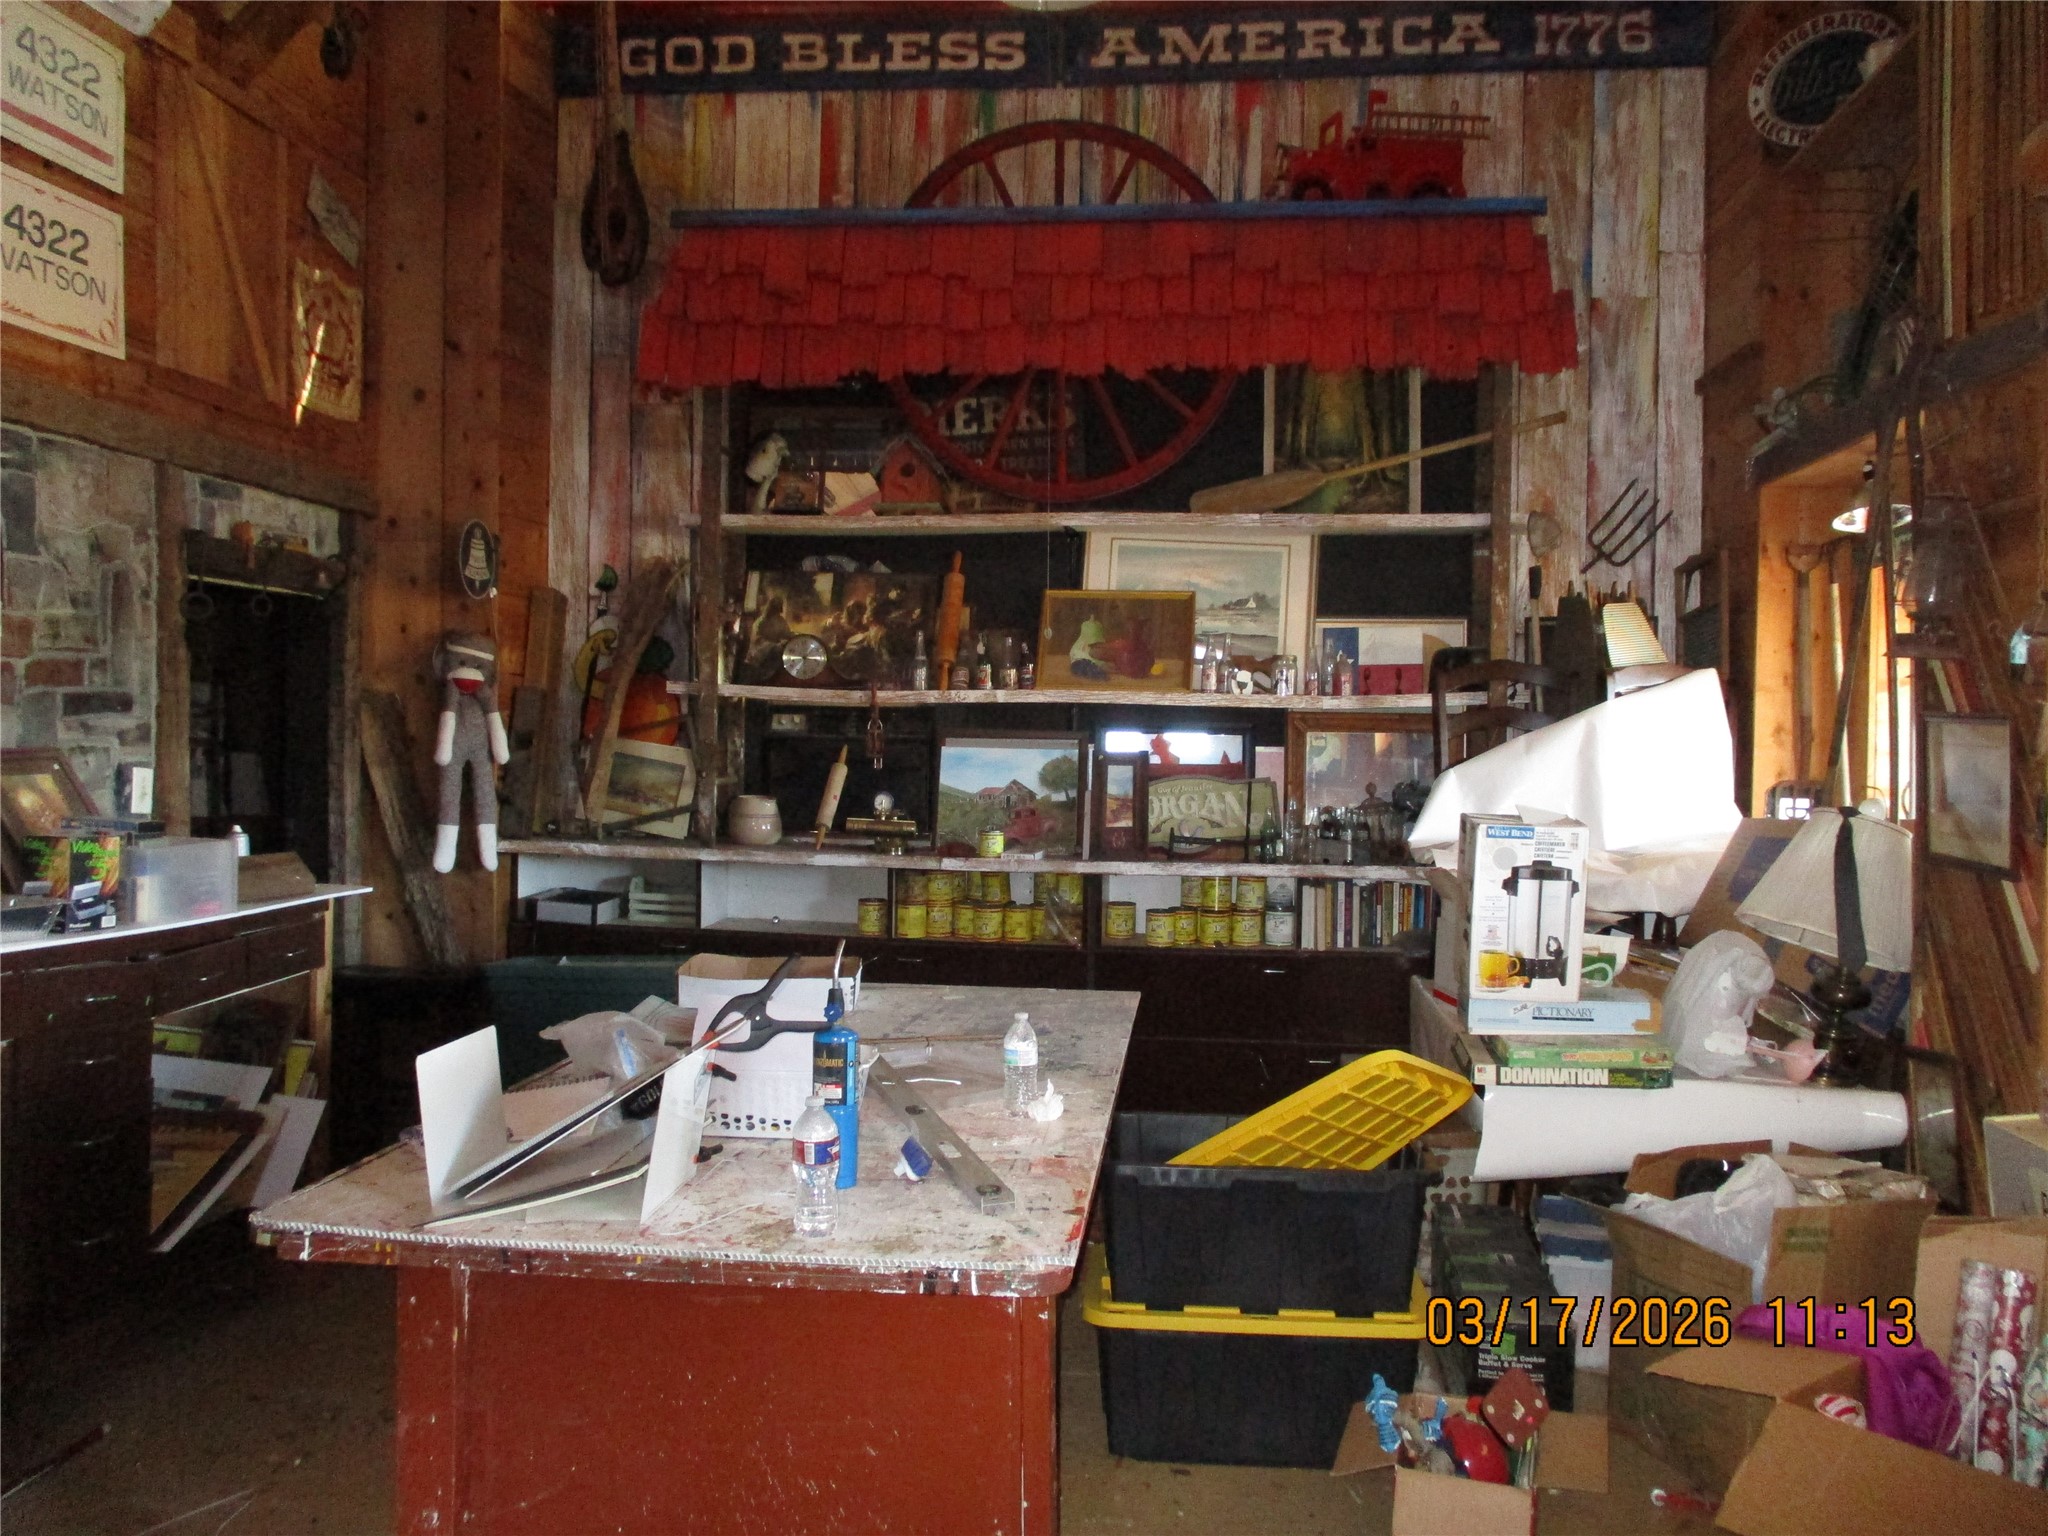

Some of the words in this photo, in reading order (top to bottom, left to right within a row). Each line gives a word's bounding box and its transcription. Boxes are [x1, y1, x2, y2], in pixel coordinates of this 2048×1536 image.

[15, 25, 102, 101] 4322
[621, 35, 757, 76] GOD
[781, 30, 1028, 73] BLESS
[1090, 12, 1503, 68] AMERICA
[1532, 9, 1656, 57] 1776
[8, 60, 109, 139] WATSON
[3, 203, 90, 267] 4322
[1487, 828, 1510, 837] WEST
[1510, 828, 1534, 838] BEND
[1532, 1006, 1594, 1018] PICTIONARY
[1499, 1066, 1609, 1086] DOMINATION
